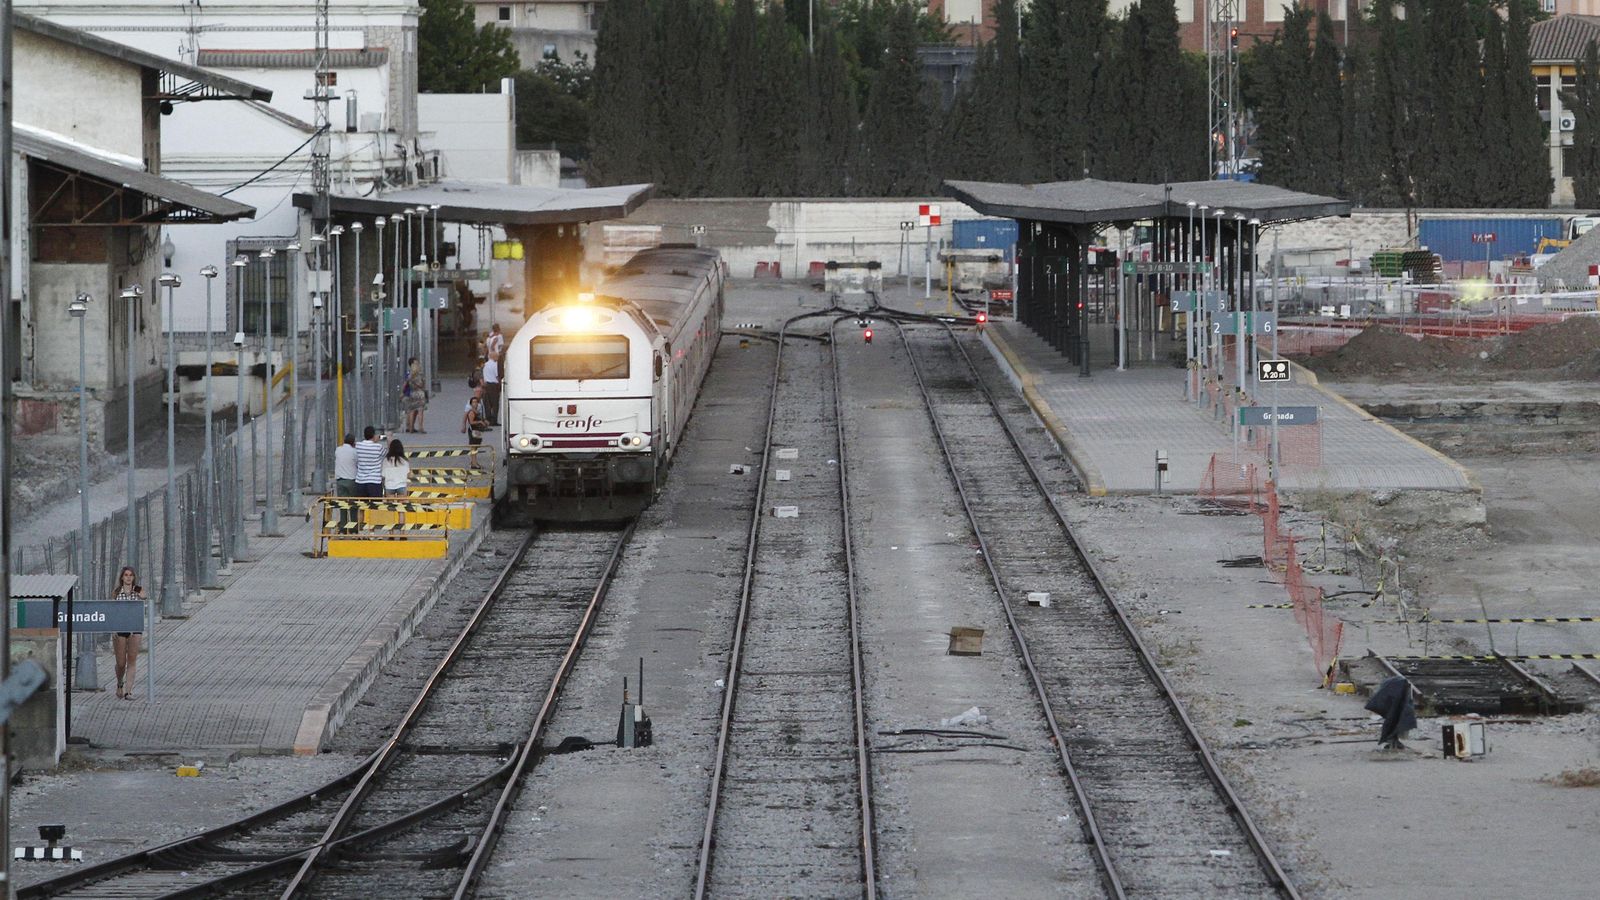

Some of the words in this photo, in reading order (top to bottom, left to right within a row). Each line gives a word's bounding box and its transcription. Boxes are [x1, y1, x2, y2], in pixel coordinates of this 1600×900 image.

[440, 298, 446, 308] 3
[1173, 301, 1179, 310] 2
[403, 319, 409, 329] 3
[1213, 323, 1220, 333] 2
[1264, 322, 1271, 332] 6
[1263, 412, 1294, 420] Grnada
[557, 415, 602, 432] renfe
